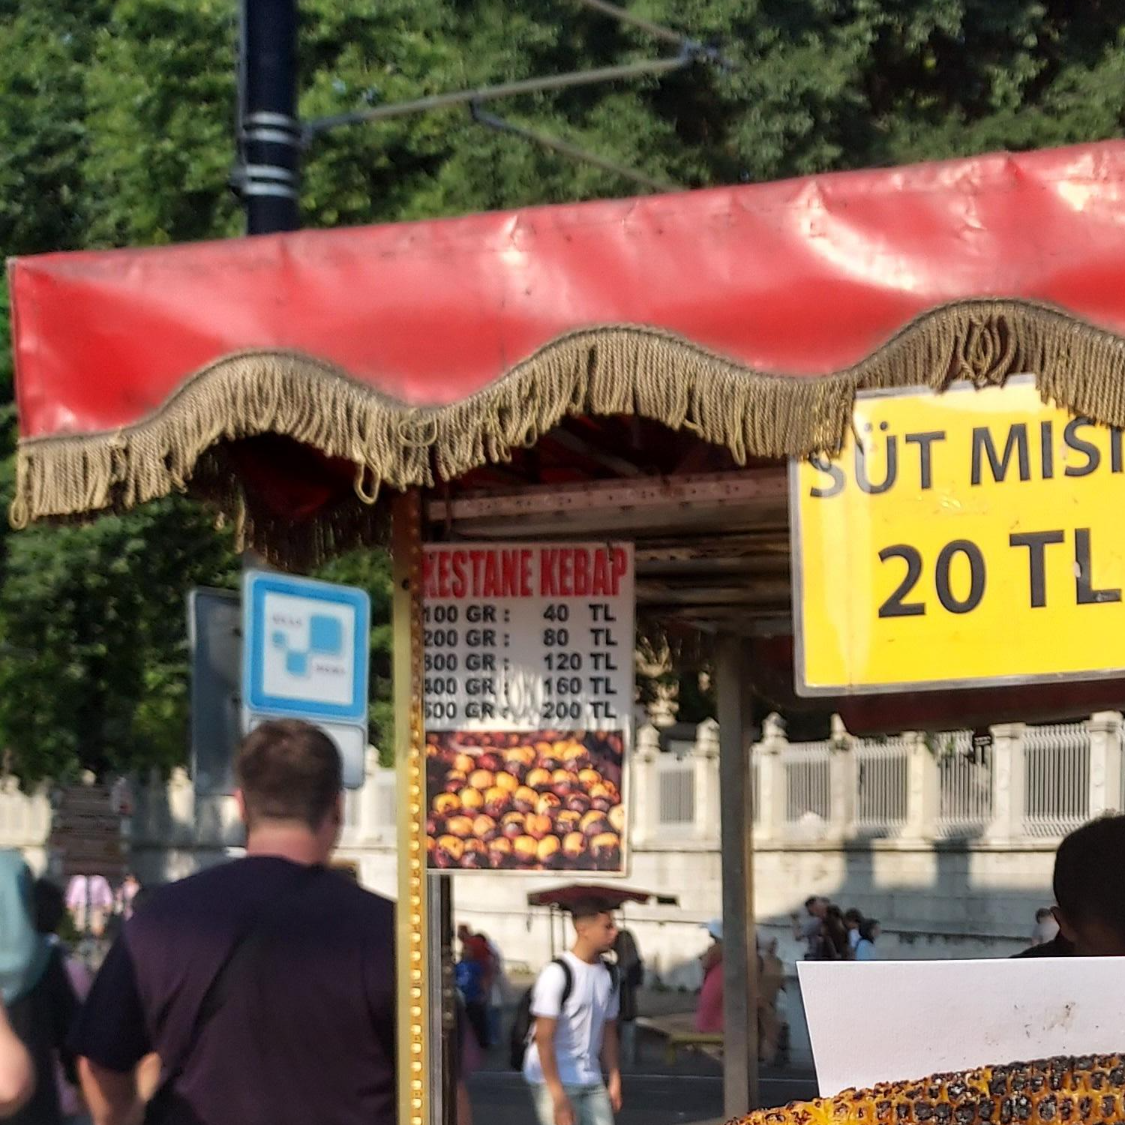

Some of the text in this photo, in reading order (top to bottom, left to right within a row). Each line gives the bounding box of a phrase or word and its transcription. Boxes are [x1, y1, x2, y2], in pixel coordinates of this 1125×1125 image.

[809, 420, 946, 498] SÜT
[423, 546, 628, 598] KESTANE KEBAP
[877, 527, 1123, 619] 20 TL
[465, 605, 497, 622] GR
[542, 603, 570, 622] 40
[588, 603, 617, 621] TL
[465, 629, 497, 647] GR
[542, 628, 570, 646] 80
[589, 628, 618, 646] TL
[465, 653, 497, 671] GR
[543, 653, 583, 671] 120
[589, 653, 618, 671] TL
[464, 677, 497, 695] GR
[543, 677, 583, 695] 160
[589, 677, 617, 695] TL
[464, 702, 495, 719] GR
[542, 701, 582, 719] 200
[589, 701, 617, 719] TL
